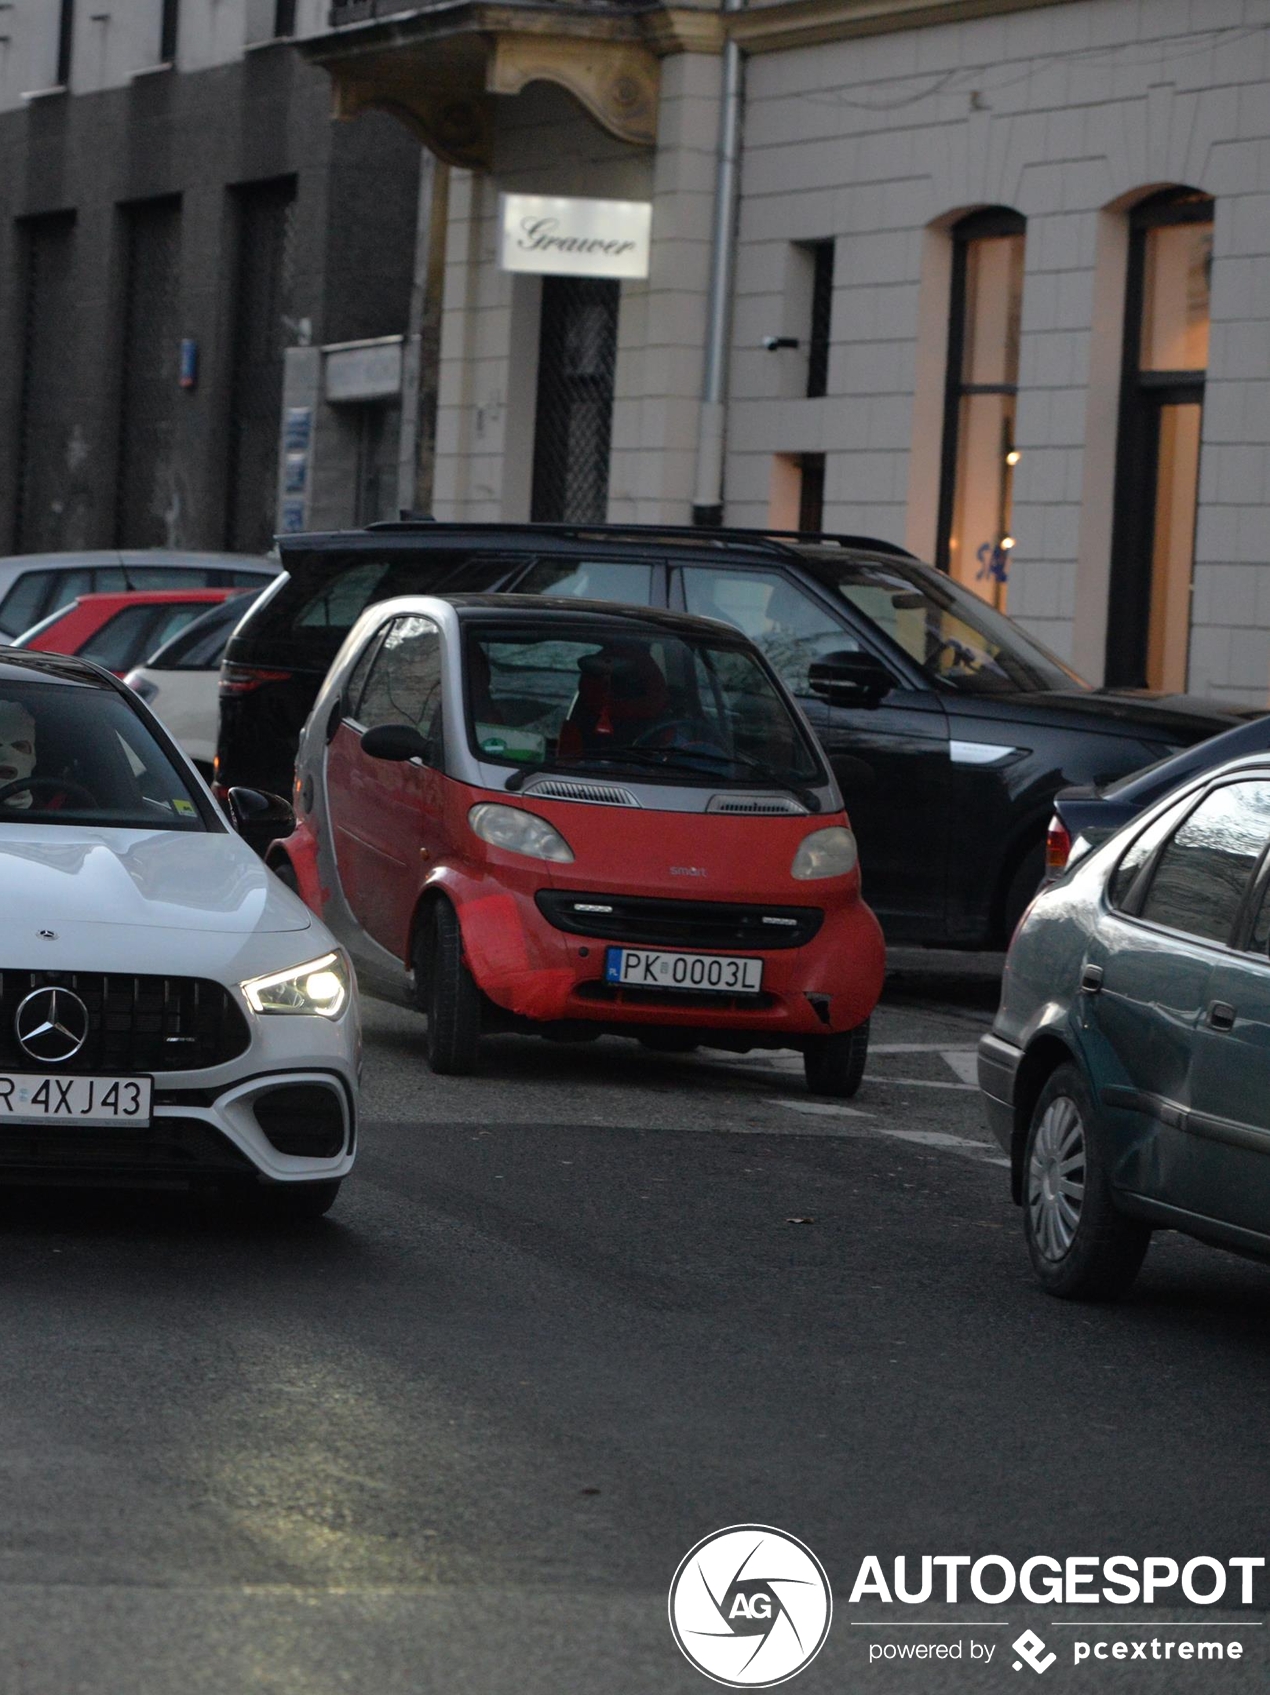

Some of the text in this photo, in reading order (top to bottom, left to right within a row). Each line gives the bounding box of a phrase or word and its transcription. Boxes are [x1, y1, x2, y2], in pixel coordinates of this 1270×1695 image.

[517, 216, 638, 256] Grawer
[624, 953, 755, 989] PK 0003L
[31, 1079, 140, 1116] 4XJ43
